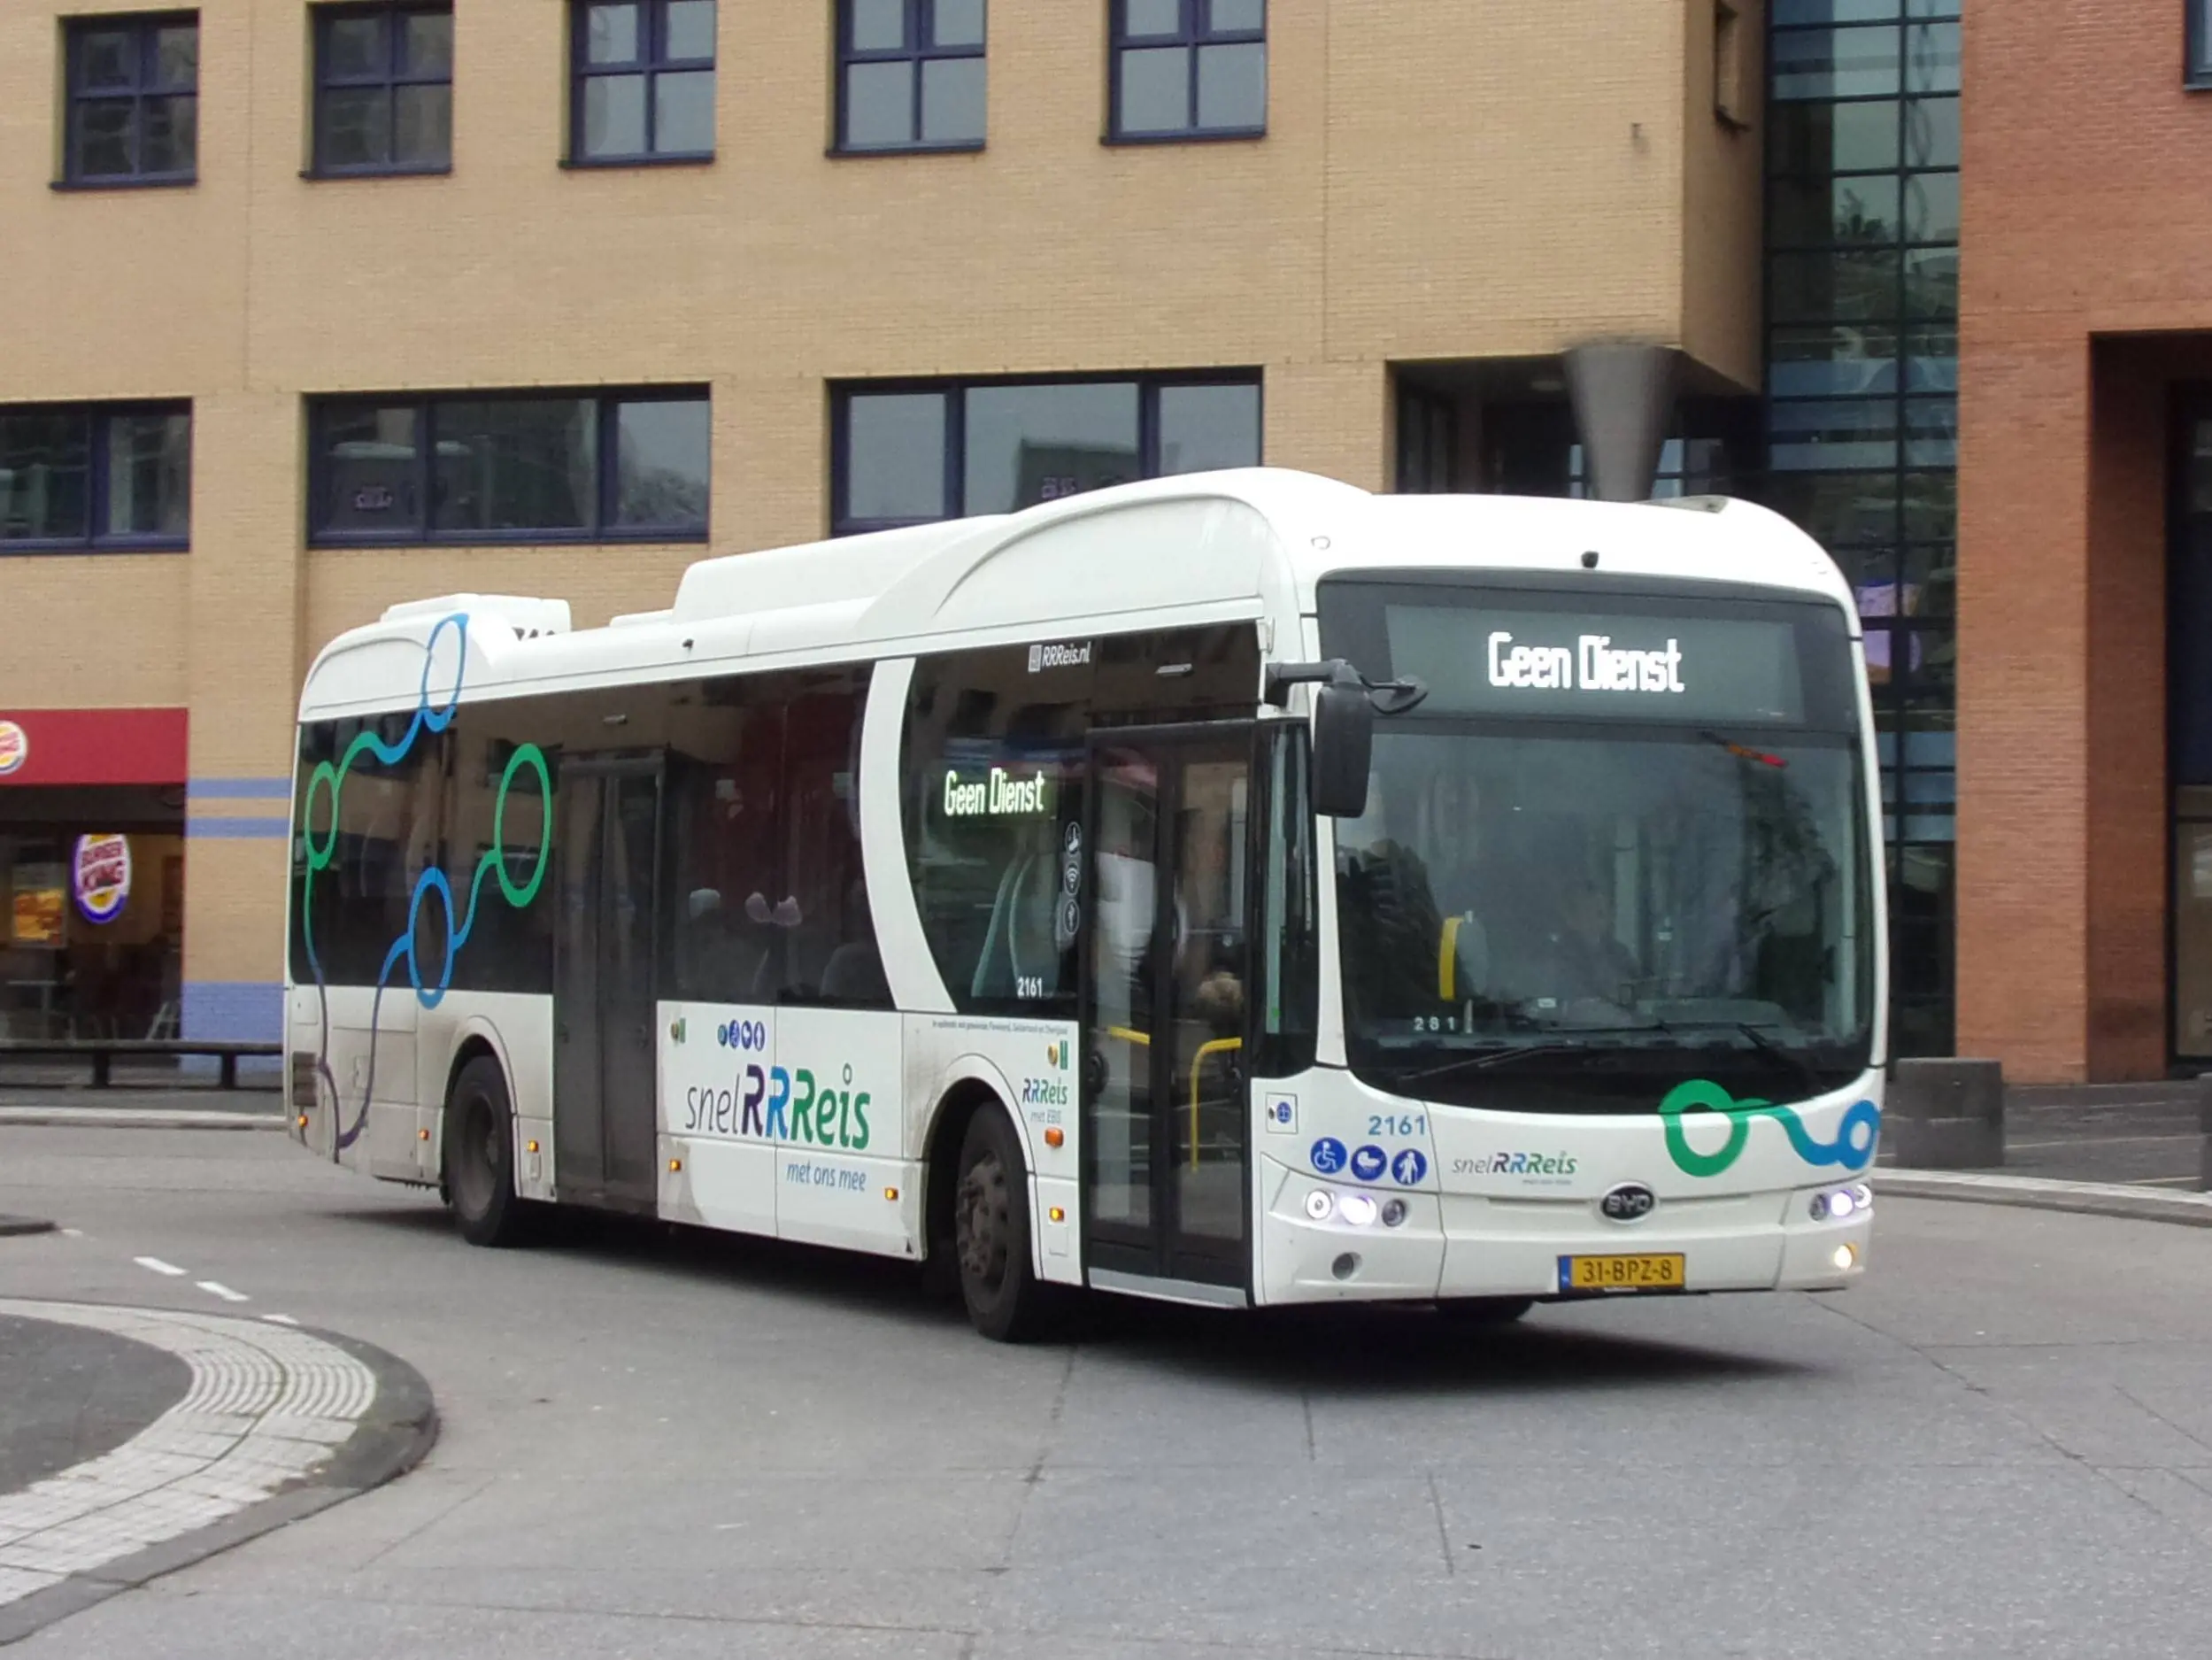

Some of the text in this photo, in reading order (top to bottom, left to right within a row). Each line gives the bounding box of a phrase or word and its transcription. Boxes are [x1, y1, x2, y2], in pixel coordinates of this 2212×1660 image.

[1042, 641, 1091, 667] RRReis.nl
[1488, 631, 1685, 692] Geen Dienst
[944, 767, 1044, 816] Geen Dienst
[1017, 977, 1043, 999] 2161
[1022, 1077, 1068, 1105] RRReis
[685, 1062, 871, 1150] snelRRReis
[1368, 1115, 1424, 1136] 2161
[787, 1158, 867, 1192] met ons mee
[1452, 1150, 1577, 1174] snelRRReis
[1607, 1195, 1650, 1213] BYD
[1583, 1259, 1673, 1283] 31-BPZ-8
